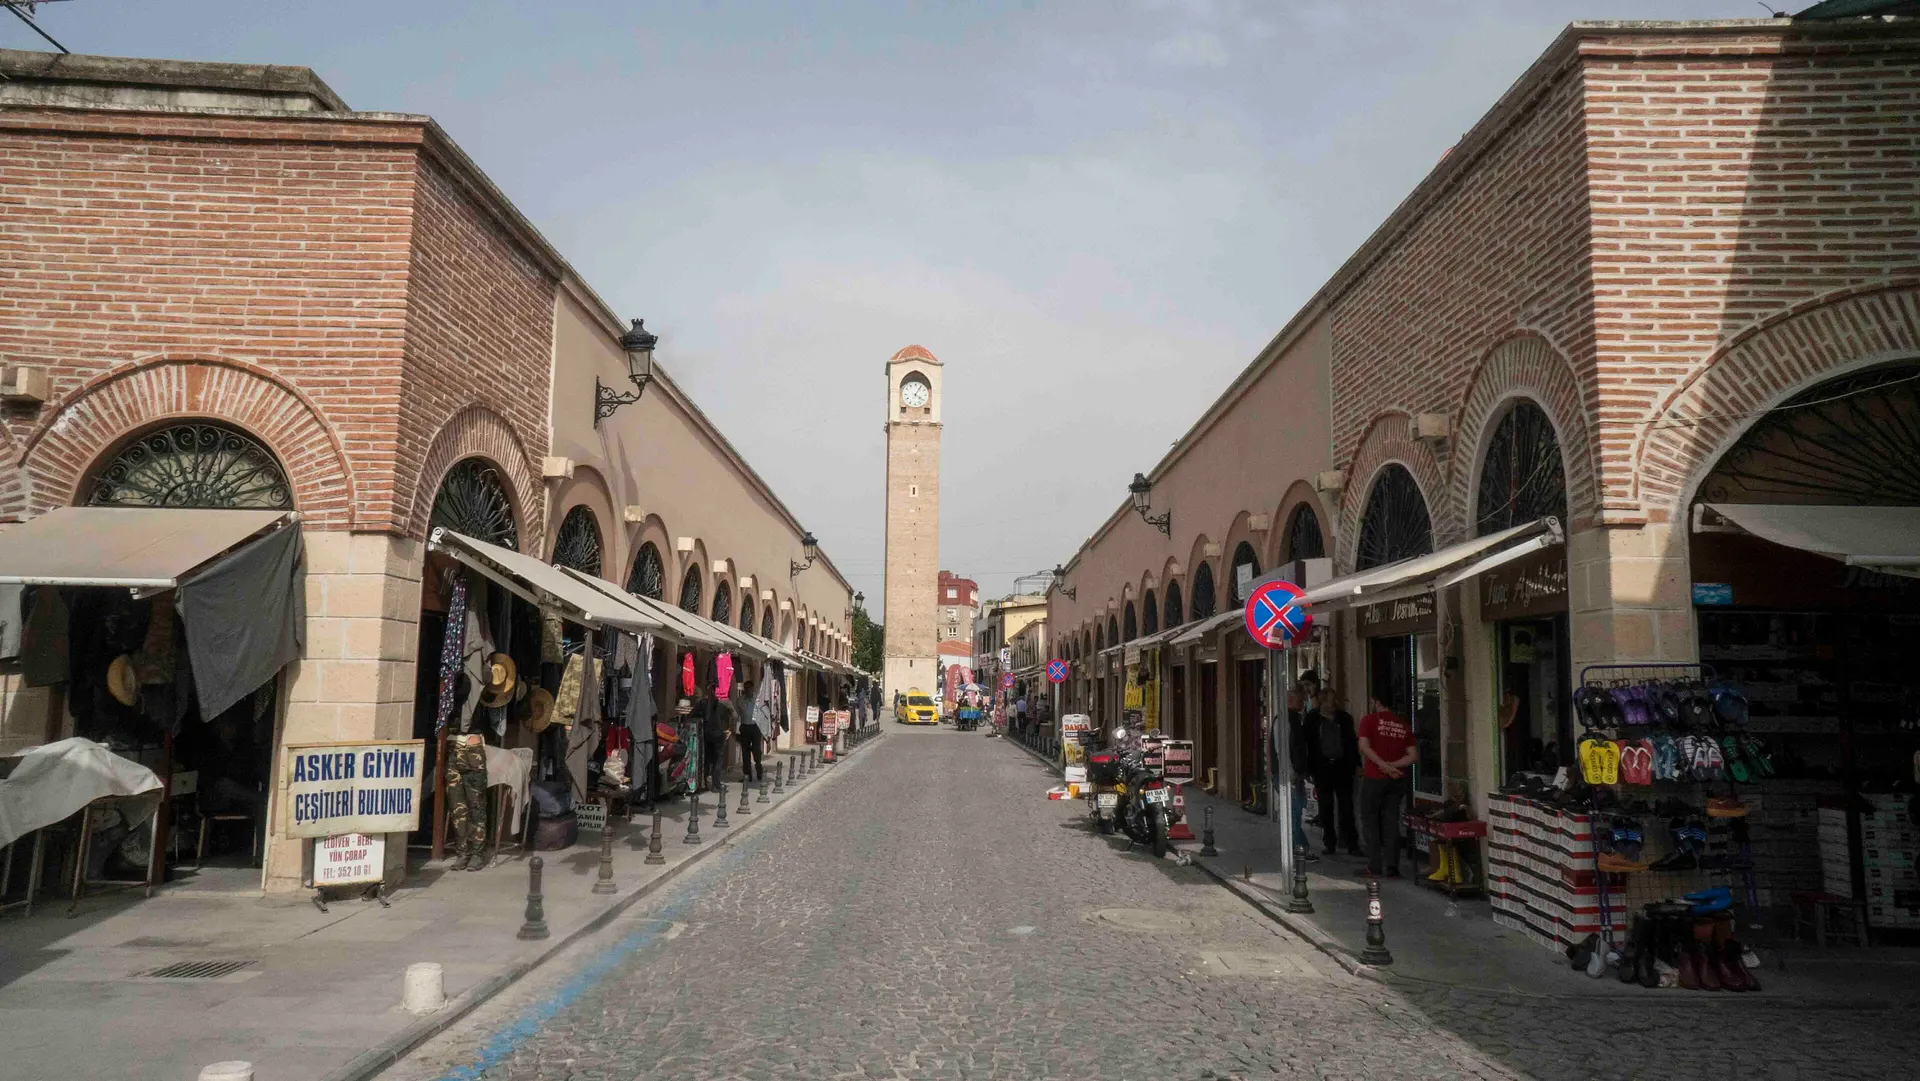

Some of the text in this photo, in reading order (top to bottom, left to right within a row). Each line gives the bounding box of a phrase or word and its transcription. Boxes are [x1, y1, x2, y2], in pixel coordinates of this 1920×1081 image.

[294, 749, 416, 782] ASKER GİYİM
[295, 786, 412, 825] ÇEŞİTLERİ BULUNUR
[329, 849, 368, 863] YÜN ÇORAP
[338, 866, 352, 878] 352
